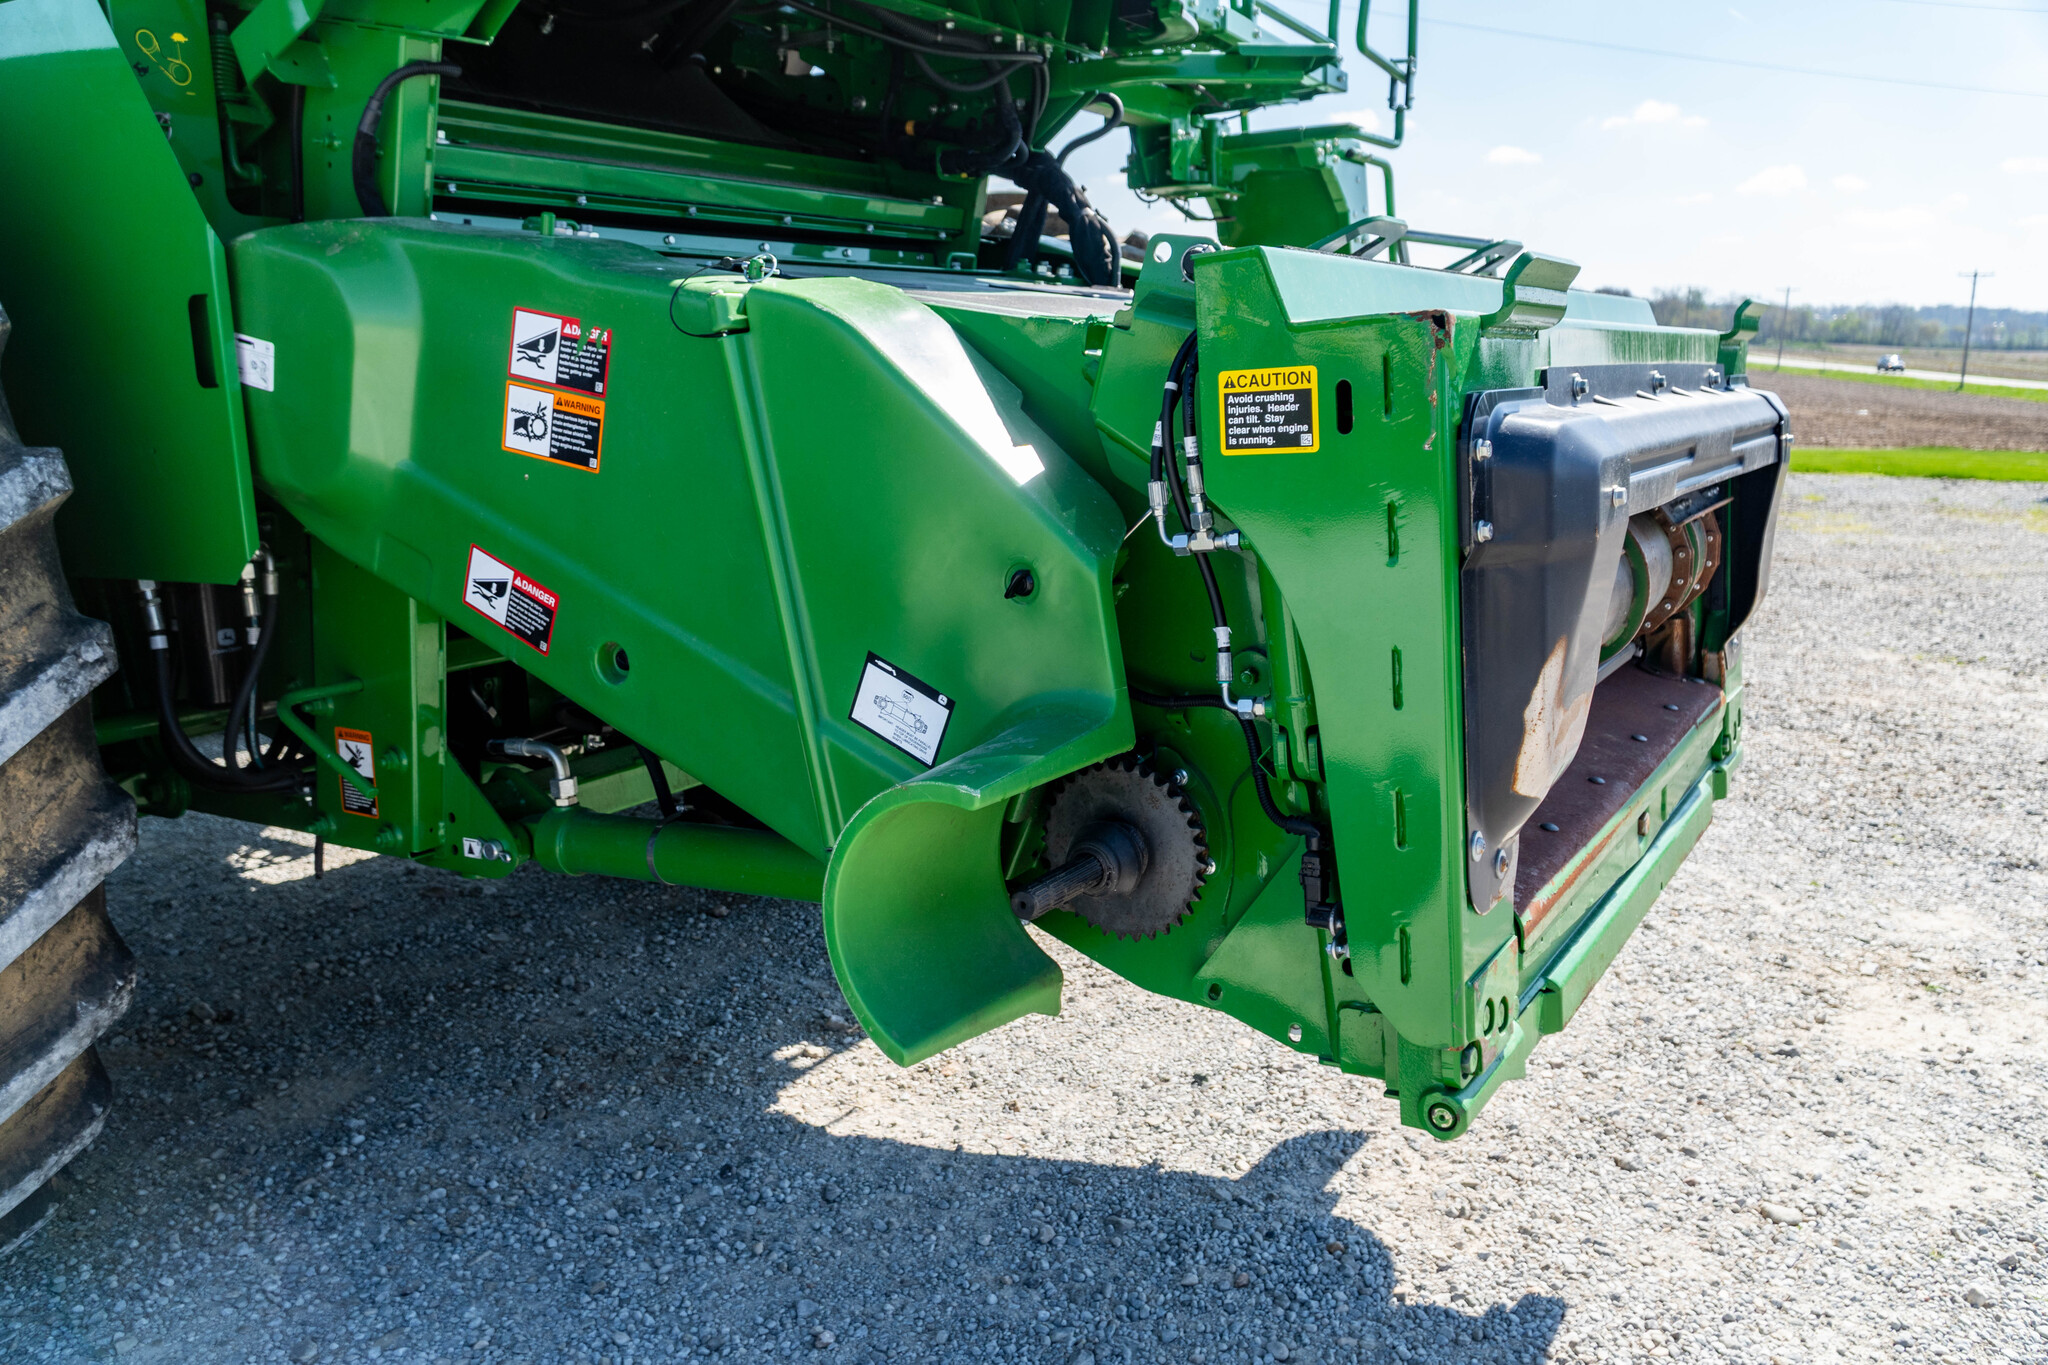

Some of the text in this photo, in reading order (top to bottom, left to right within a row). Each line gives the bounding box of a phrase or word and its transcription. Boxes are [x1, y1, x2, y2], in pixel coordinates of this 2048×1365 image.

[1237, 371, 1311, 388] CAUTION
[1228, 392, 1294, 404] Avoid crushing
[564, 399, 600, 414] WARNING
[1228, 403, 1299, 415] injuries. Header
[1246, 415, 1260, 424] tilt.
[1265, 414, 1285, 424] Stay
[1228, 423, 1308, 434] clear when engine
[1228, 435, 1276, 446] is running.
[522, 580, 555, 608] DANGER
